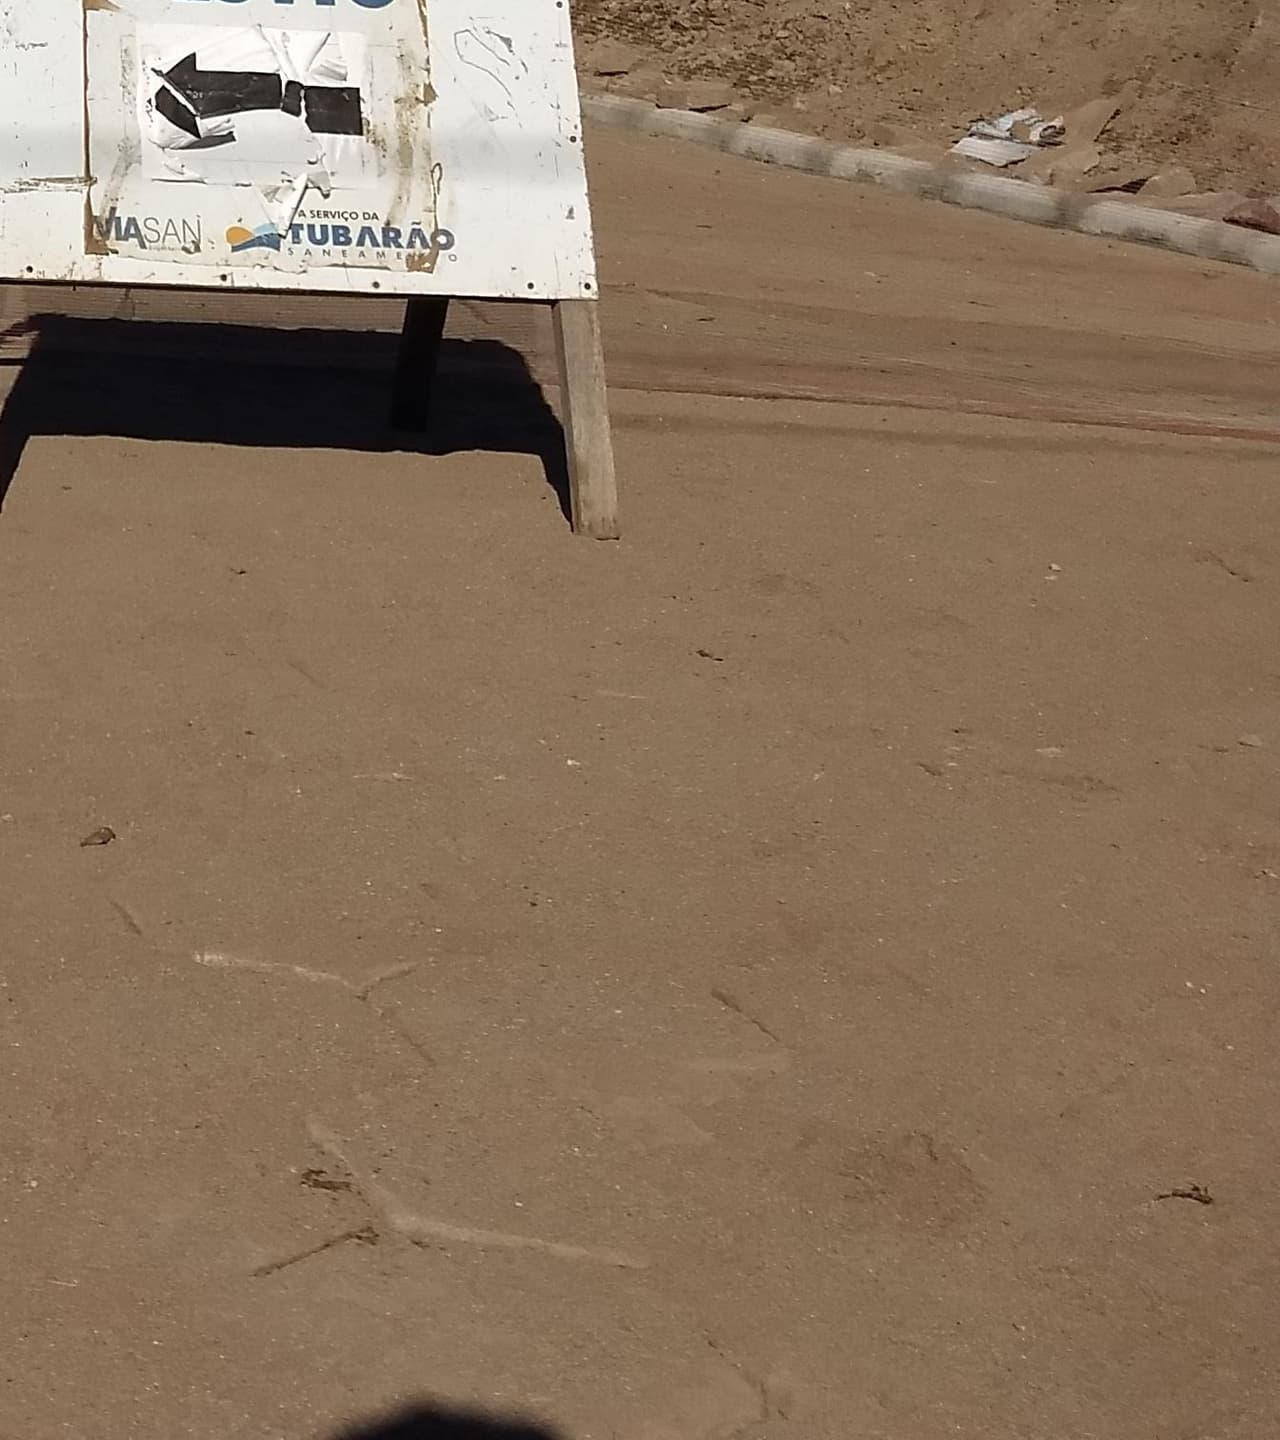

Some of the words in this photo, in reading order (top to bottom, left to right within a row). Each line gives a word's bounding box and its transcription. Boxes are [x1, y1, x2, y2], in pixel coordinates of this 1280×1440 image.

[298, 210, 307, 219] A
[310, 209, 358, 222] SERVIÇO
[362, 210, 380, 221] DA
[291, 221, 456, 252] TUBARÃO
[288, 248, 458, 263] SANEAMEO
